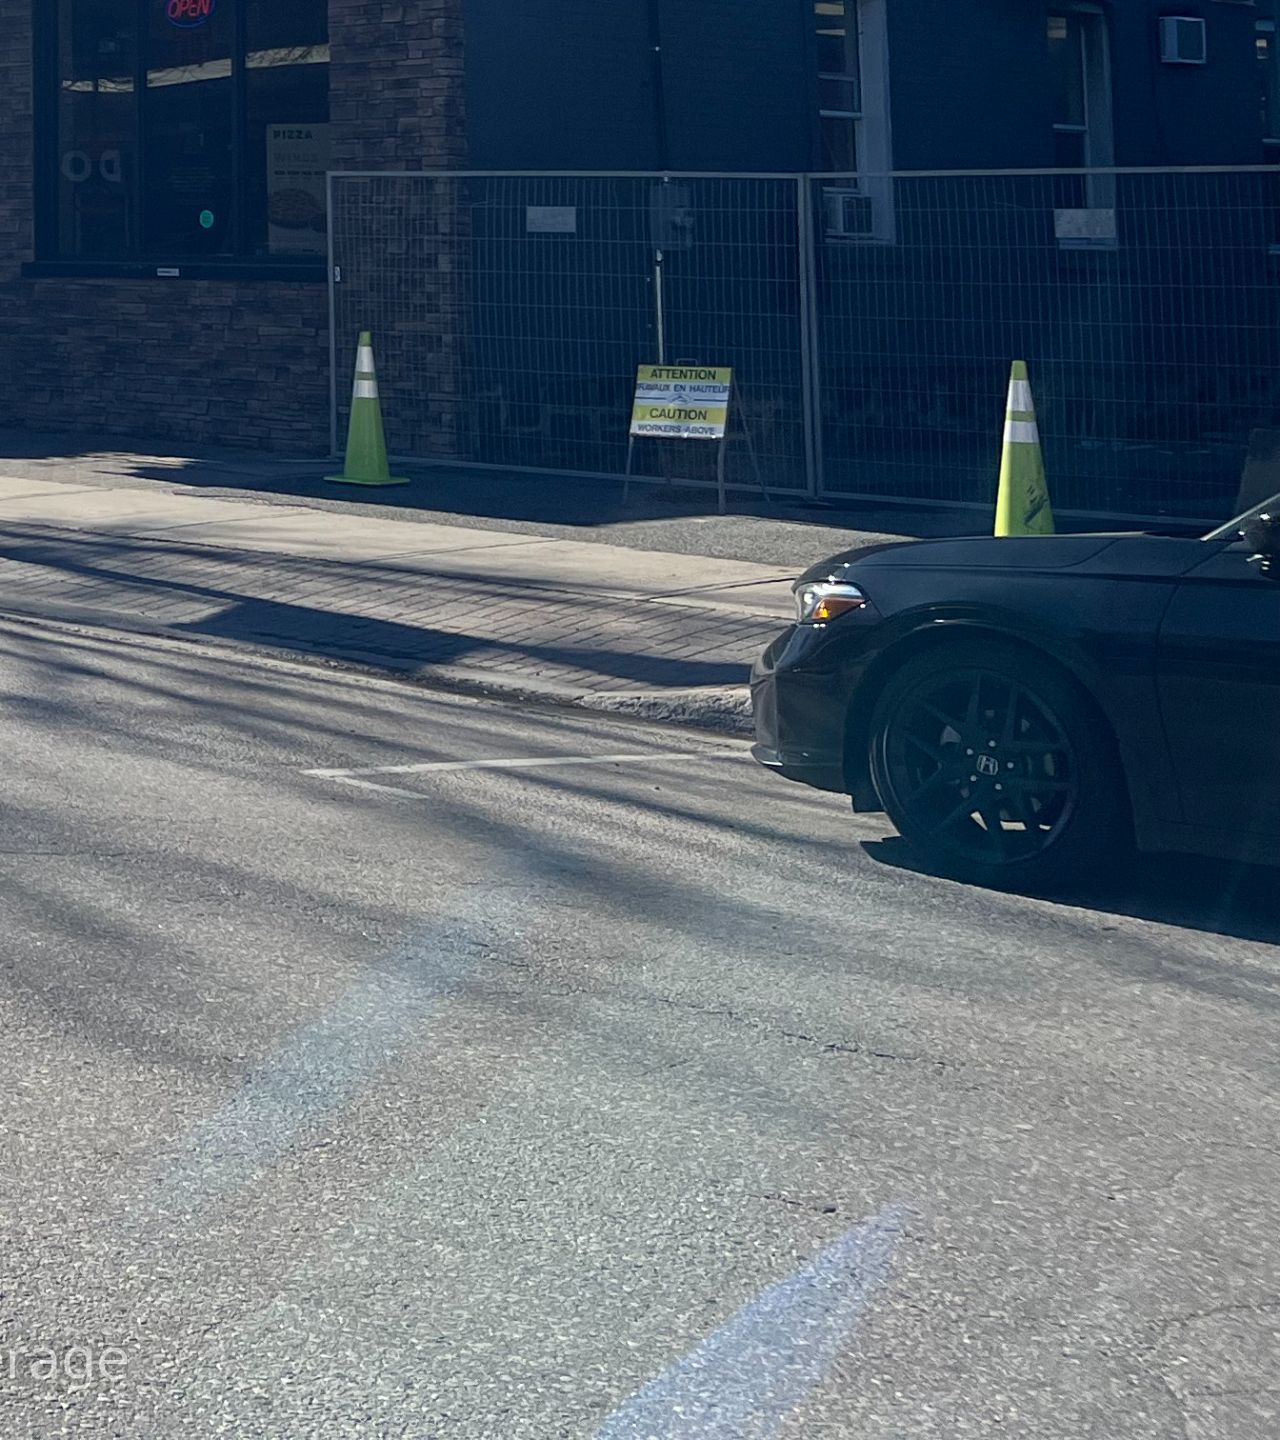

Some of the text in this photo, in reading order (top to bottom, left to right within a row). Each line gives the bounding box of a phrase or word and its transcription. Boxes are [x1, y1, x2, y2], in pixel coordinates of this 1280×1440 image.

[273, 129, 313, 141] PIZZA
[650, 368, 717, 380] ATTENTION
[674, 383, 686, 392] EN
[649, 407, 707, 421] CAUTION
[638, 424, 681, 433] WORKERS
